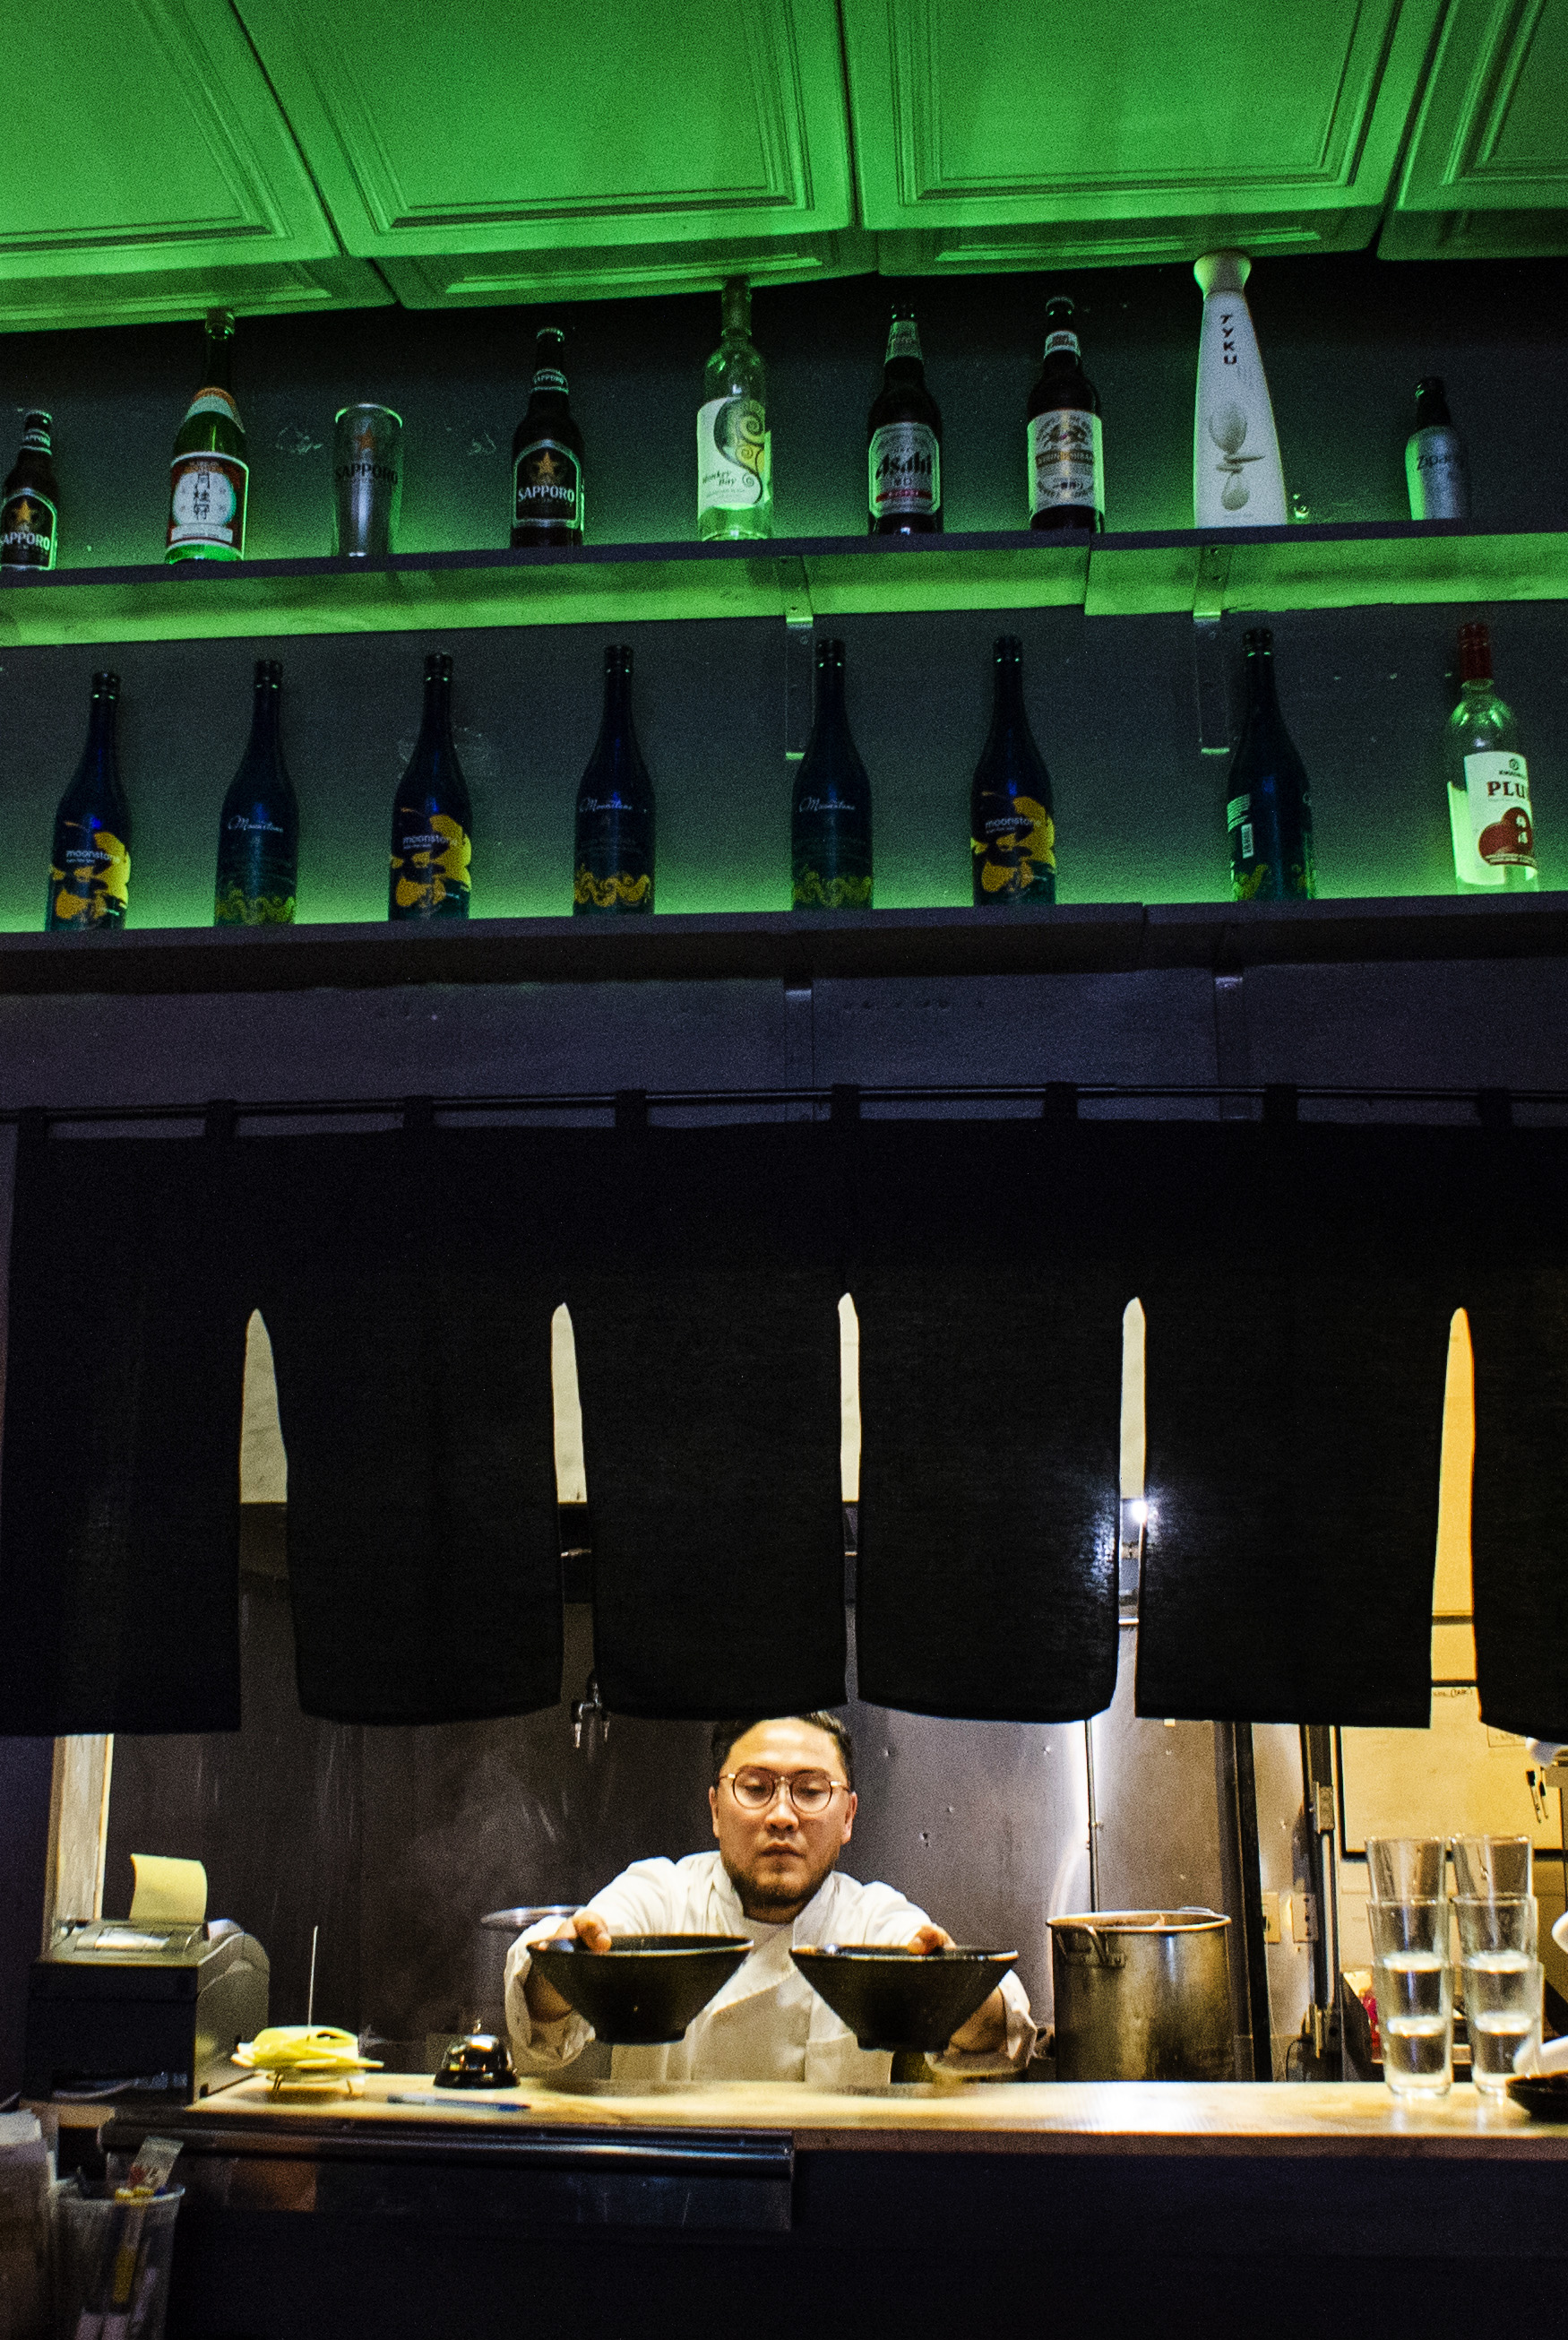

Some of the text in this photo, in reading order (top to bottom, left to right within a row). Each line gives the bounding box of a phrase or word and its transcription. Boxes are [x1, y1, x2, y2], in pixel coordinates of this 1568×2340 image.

[1219, 314, 1237, 365] TYKU
[335, 462, 399, 485] SAPPORO
[875, 452, 932, 479] Asahi
[518, 485, 575, 503] SAPPORO
